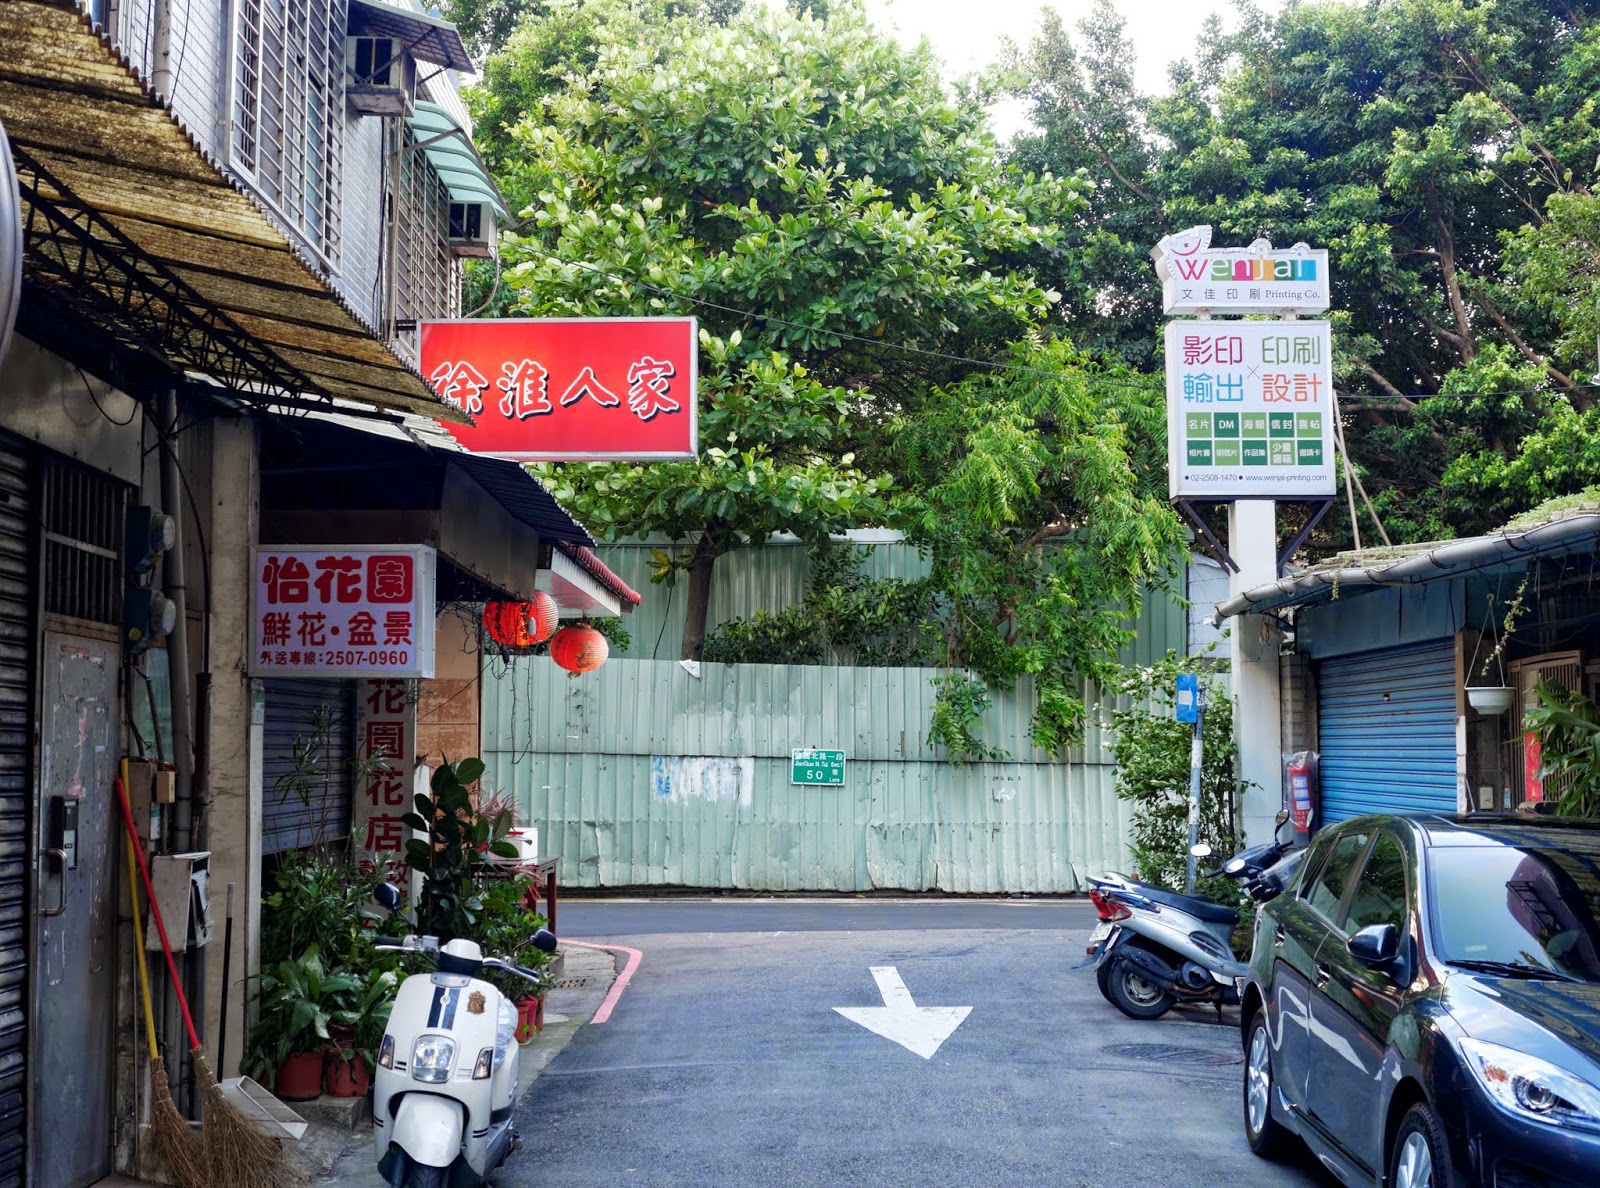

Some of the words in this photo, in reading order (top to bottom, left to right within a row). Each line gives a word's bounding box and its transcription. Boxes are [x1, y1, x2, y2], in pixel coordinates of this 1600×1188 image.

[1182, 288, 1261, 300] 文佳印刷
[1265, 289, 1302, 300] Printing
[1304, 290, 1320, 299] Co.
[1183, 335, 1243, 365] 影印
[1262, 336, 1321, 365] 印刷
[430, 356, 681, 420] 徐淮人家
[1184, 373, 1244, 403] 輸出
[1262, 373, 1322, 403] 設計
[1188, 419, 1209, 430] 名片
[1218, 420, 1234, 429] DM
[1243, 419, 1265, 430] 海報
[1271, 419, 1292, 430] 信封
[1298, 419, 1320, 430] 喜帖
[1216, 448, 1238, 457] 明信片
[1243, 448, 1266, 457] 作品集
[1272, 442, 1291, 452] 少量
[1245, 473, 1327, 482] www.wenjai-printing.com
[262, 555, 413, 604] 怡花園
[806, 769, 824, 780] 50
